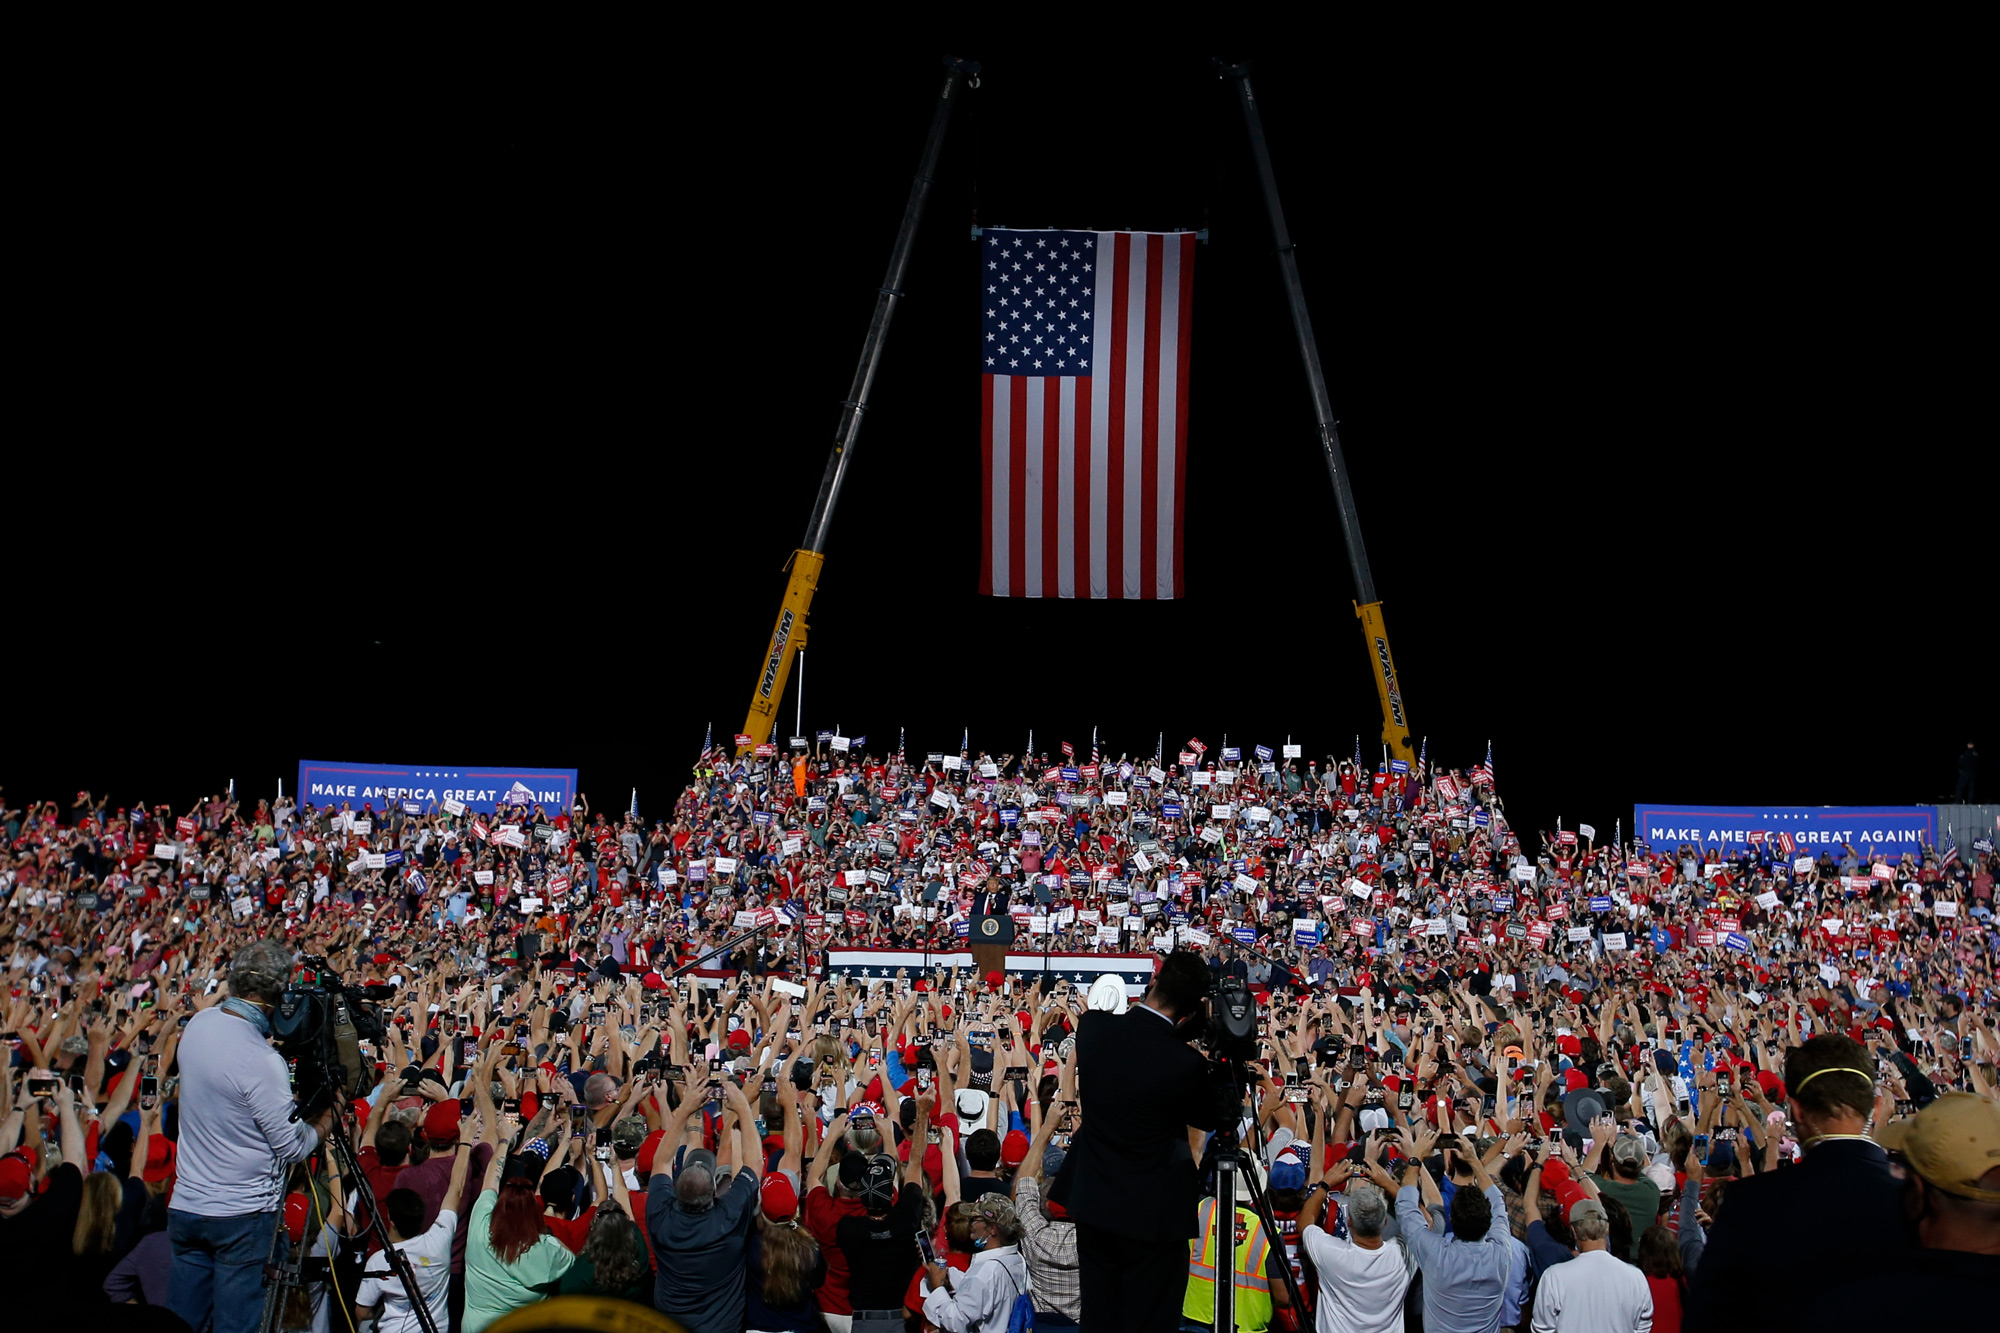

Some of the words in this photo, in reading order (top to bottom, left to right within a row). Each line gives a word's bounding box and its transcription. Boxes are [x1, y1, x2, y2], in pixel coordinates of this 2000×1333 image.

[760, 608, 794, 698] MAXIM
[1375, 637, 1405, 727] MAXIM
[311, 783, 356, 797] MAKE
[443, 789, 497, 801] GREAT
[502, 791, 561, 803] AAIN!
[1651, 828, 1700, 841] MAKE
[1795, 831, 1853, 843] GREAT
[1860, 830, 1921, 843] AGAIN!
